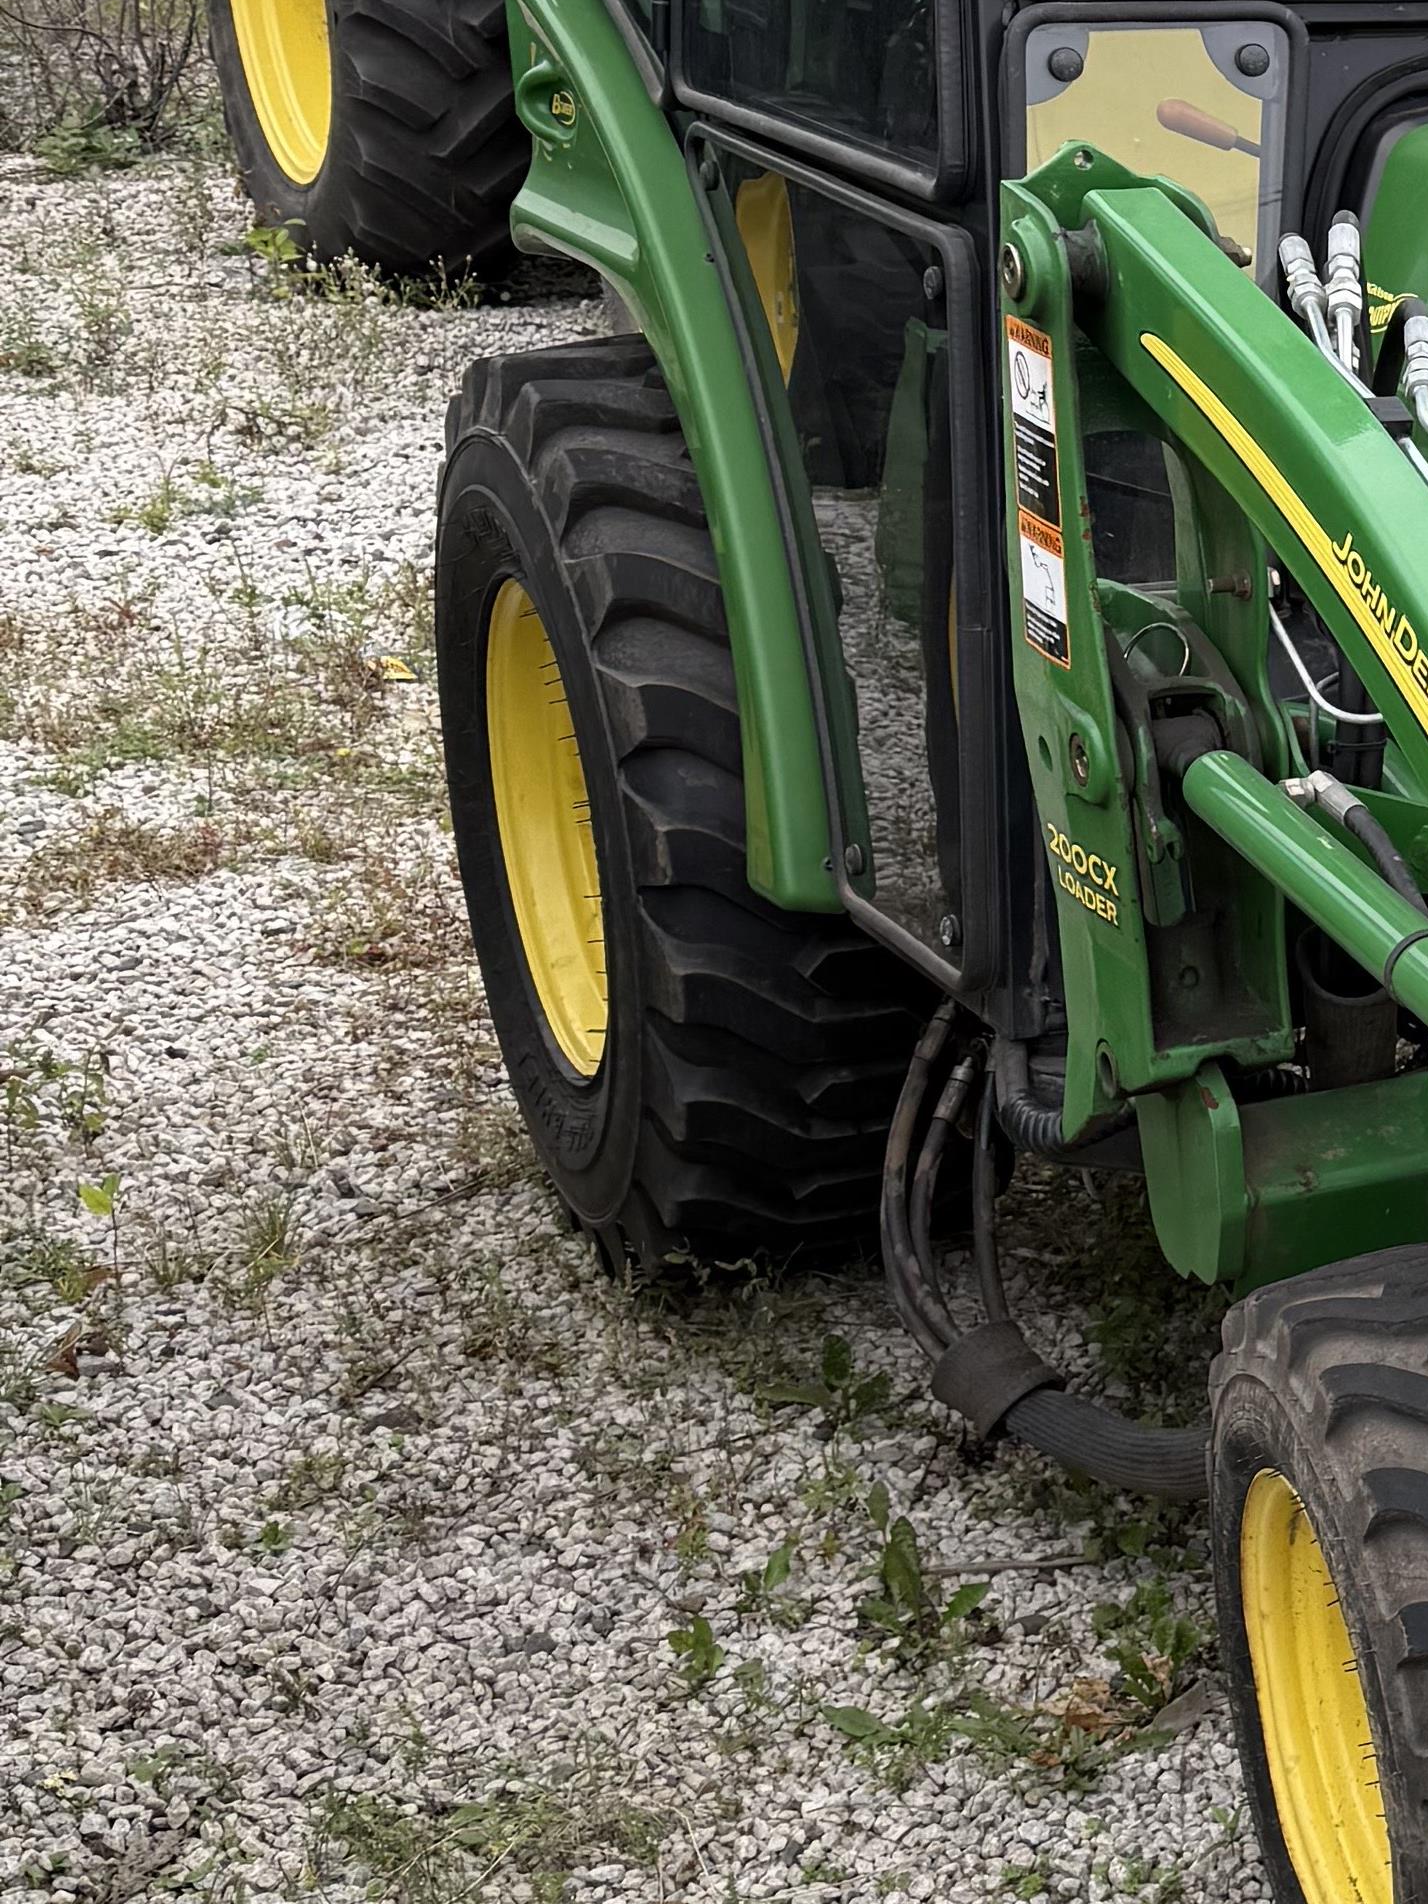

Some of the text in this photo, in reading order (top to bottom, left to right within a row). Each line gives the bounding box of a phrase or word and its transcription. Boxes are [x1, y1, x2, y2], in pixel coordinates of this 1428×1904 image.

[1332, 532, 1396, 639] JOHN
[1047, 822, 1119, 896] 200CX
[1058, 864, 1119, 926] LOADER
